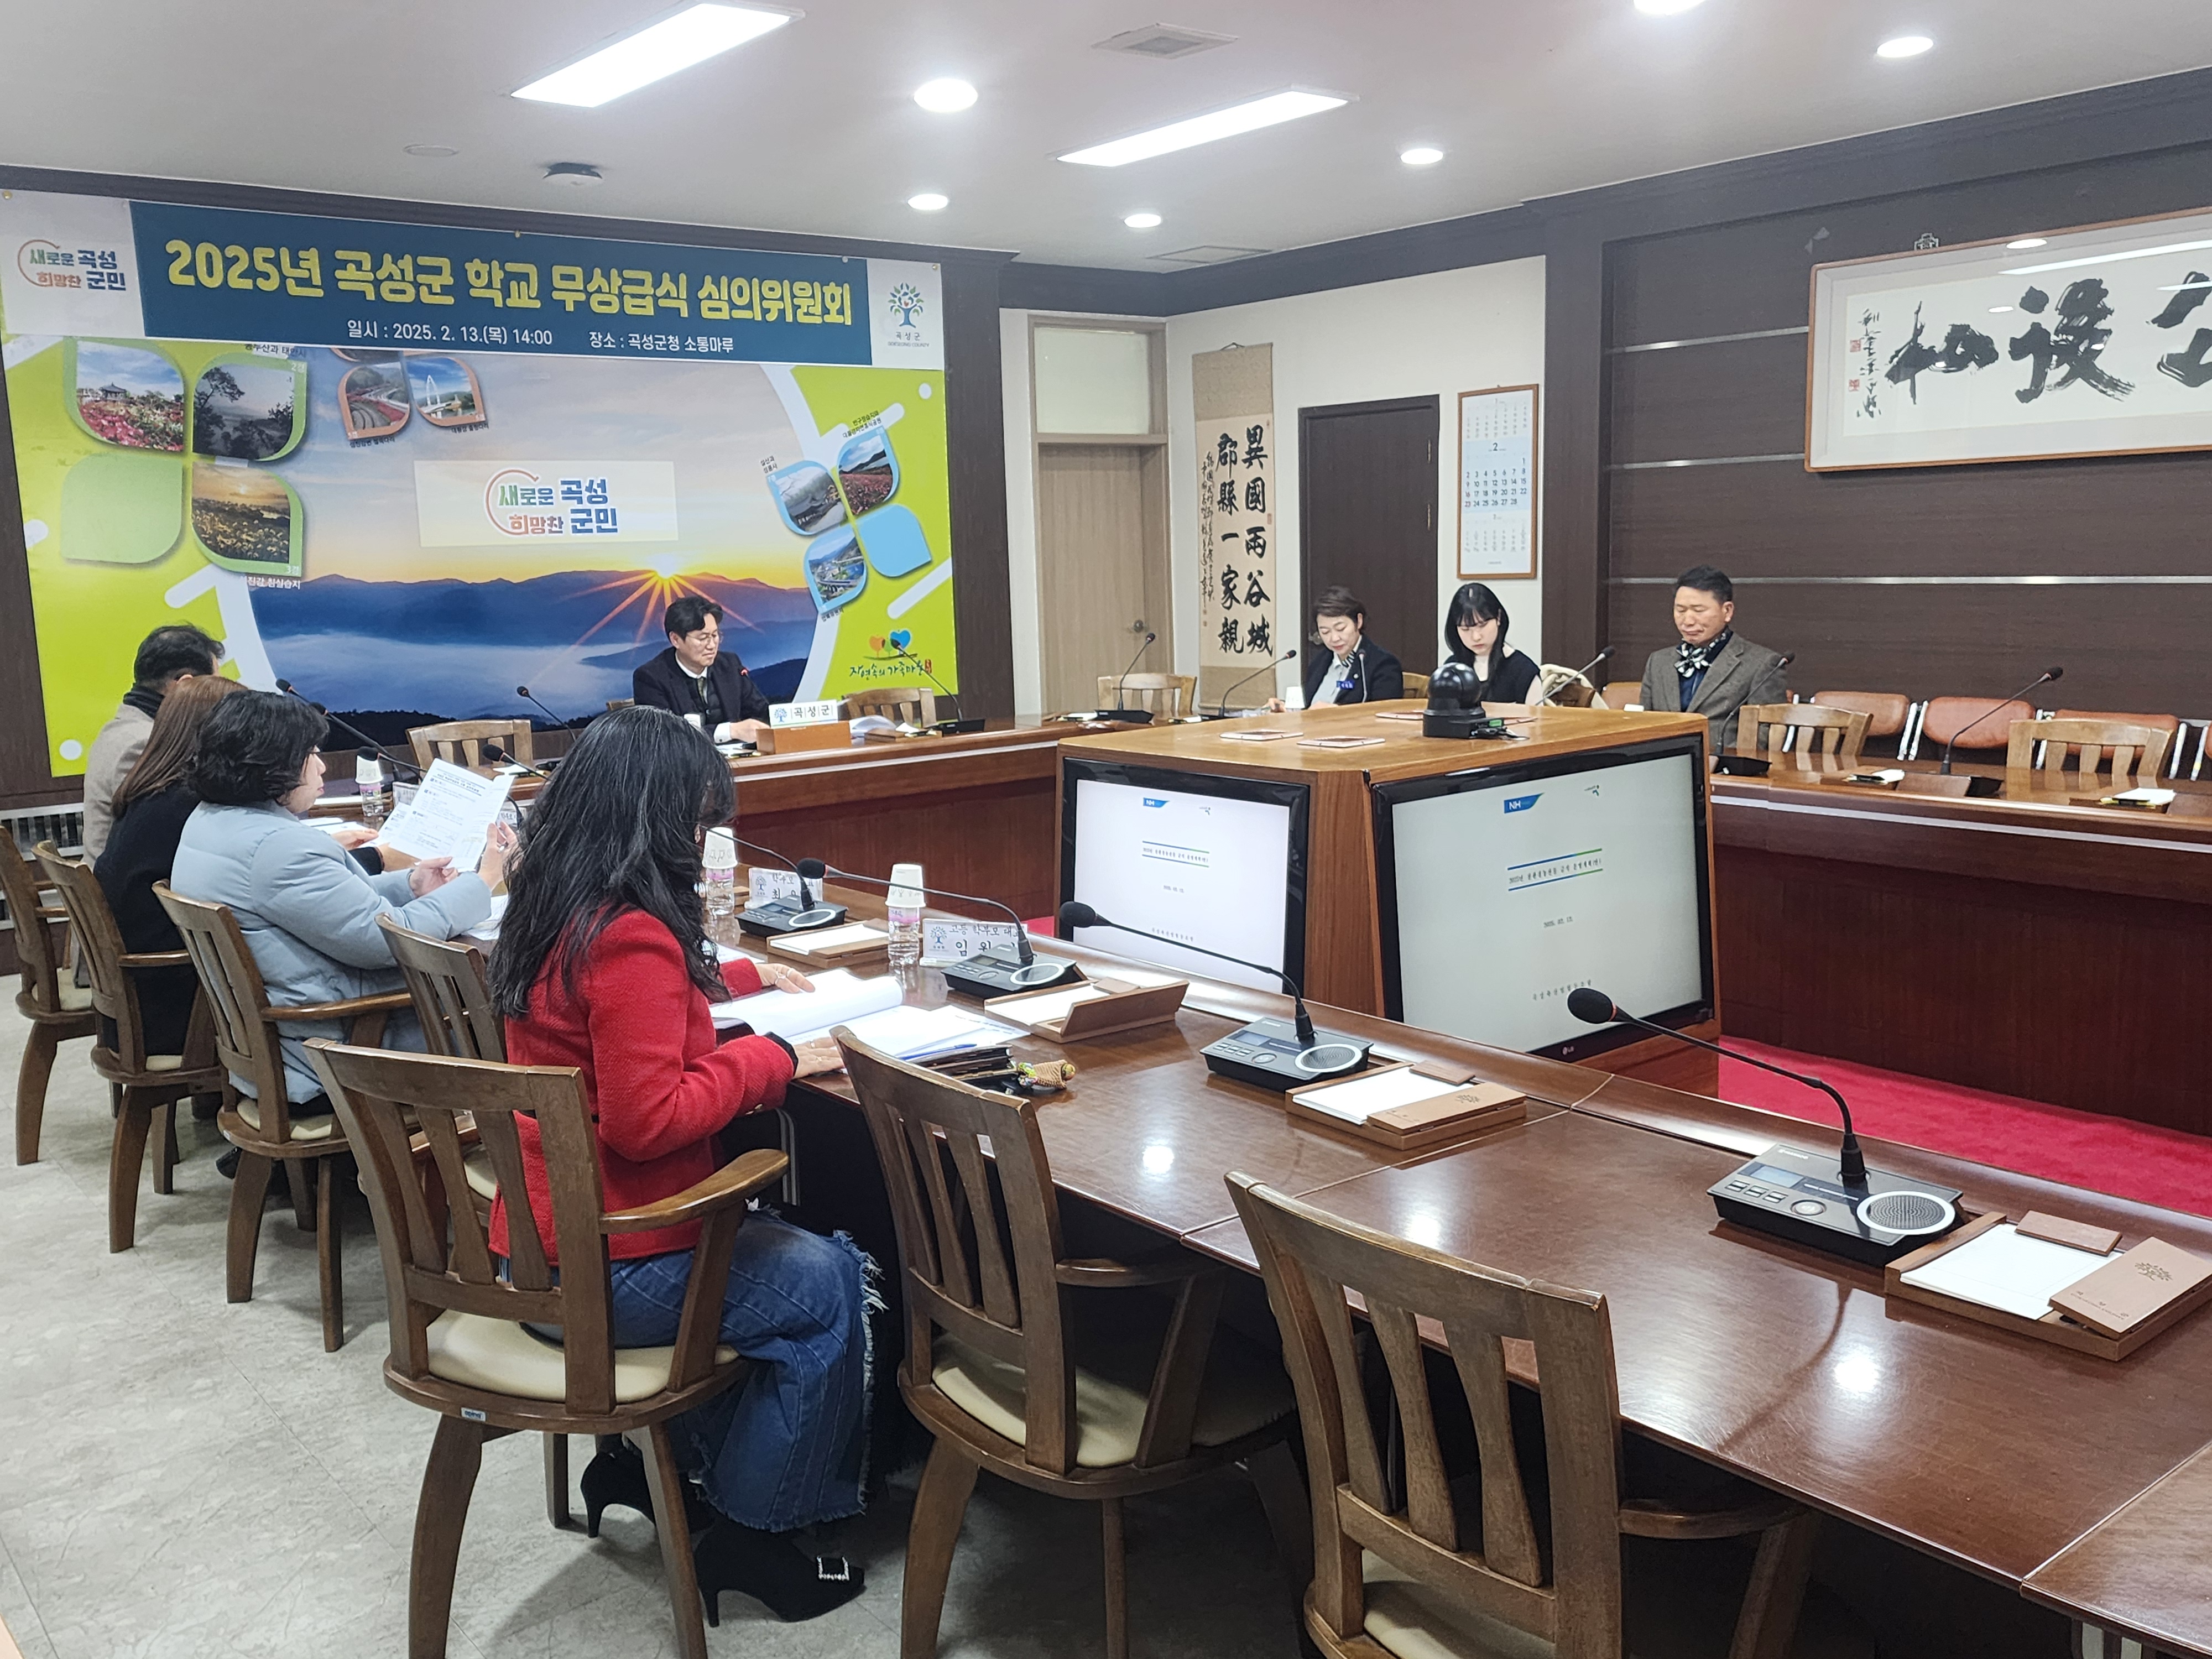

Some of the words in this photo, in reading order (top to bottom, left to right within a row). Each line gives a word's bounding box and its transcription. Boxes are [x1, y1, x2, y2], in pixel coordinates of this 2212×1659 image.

[30, 249, 75, 267] 새로운
[77, 250, 117, 269] 곡성
[36, 271, 81, 288] 희망찬
[86, 270, 126, 291] 군민
[165, 239, 324, 297] 2025년
[335, 250, 455, 305] 곡성군
[465, 258, 541, 309] 학교
[551, 265, 688, 317] 무상급식
[697, 274, 852, 325] 심의위원회
[347, 320, 378, 339] 일시
[393, 323, 436, 340] 2025.
[441, 326, 455, 341] 2.
[461, 327, 508, 345] 13.(목)
[513, 328, 552, 345] 14:00
[589, 331, 616, 348] 장소
[627, 333, 680, 351] 곡성군청
[684, 336, 734, 353] 소통마루
[896, 331, 920, 341] 곡성군
[1493, 442, 1498, 451] 2
[499, 485, 554, 506] 새로운
[560, 479, 608, 505] 곡성
[509, 514, 564, 535] 희망찬
[570, 508, 618, 534] 군민
[794, 705, 830, 718] 곡성군
[1509, 800, 1521, 810] NH
[949, 924, 968, 935] 고등
[973, 924, 1000, 936] 학부모
[956, 940, 967, 957] 임
